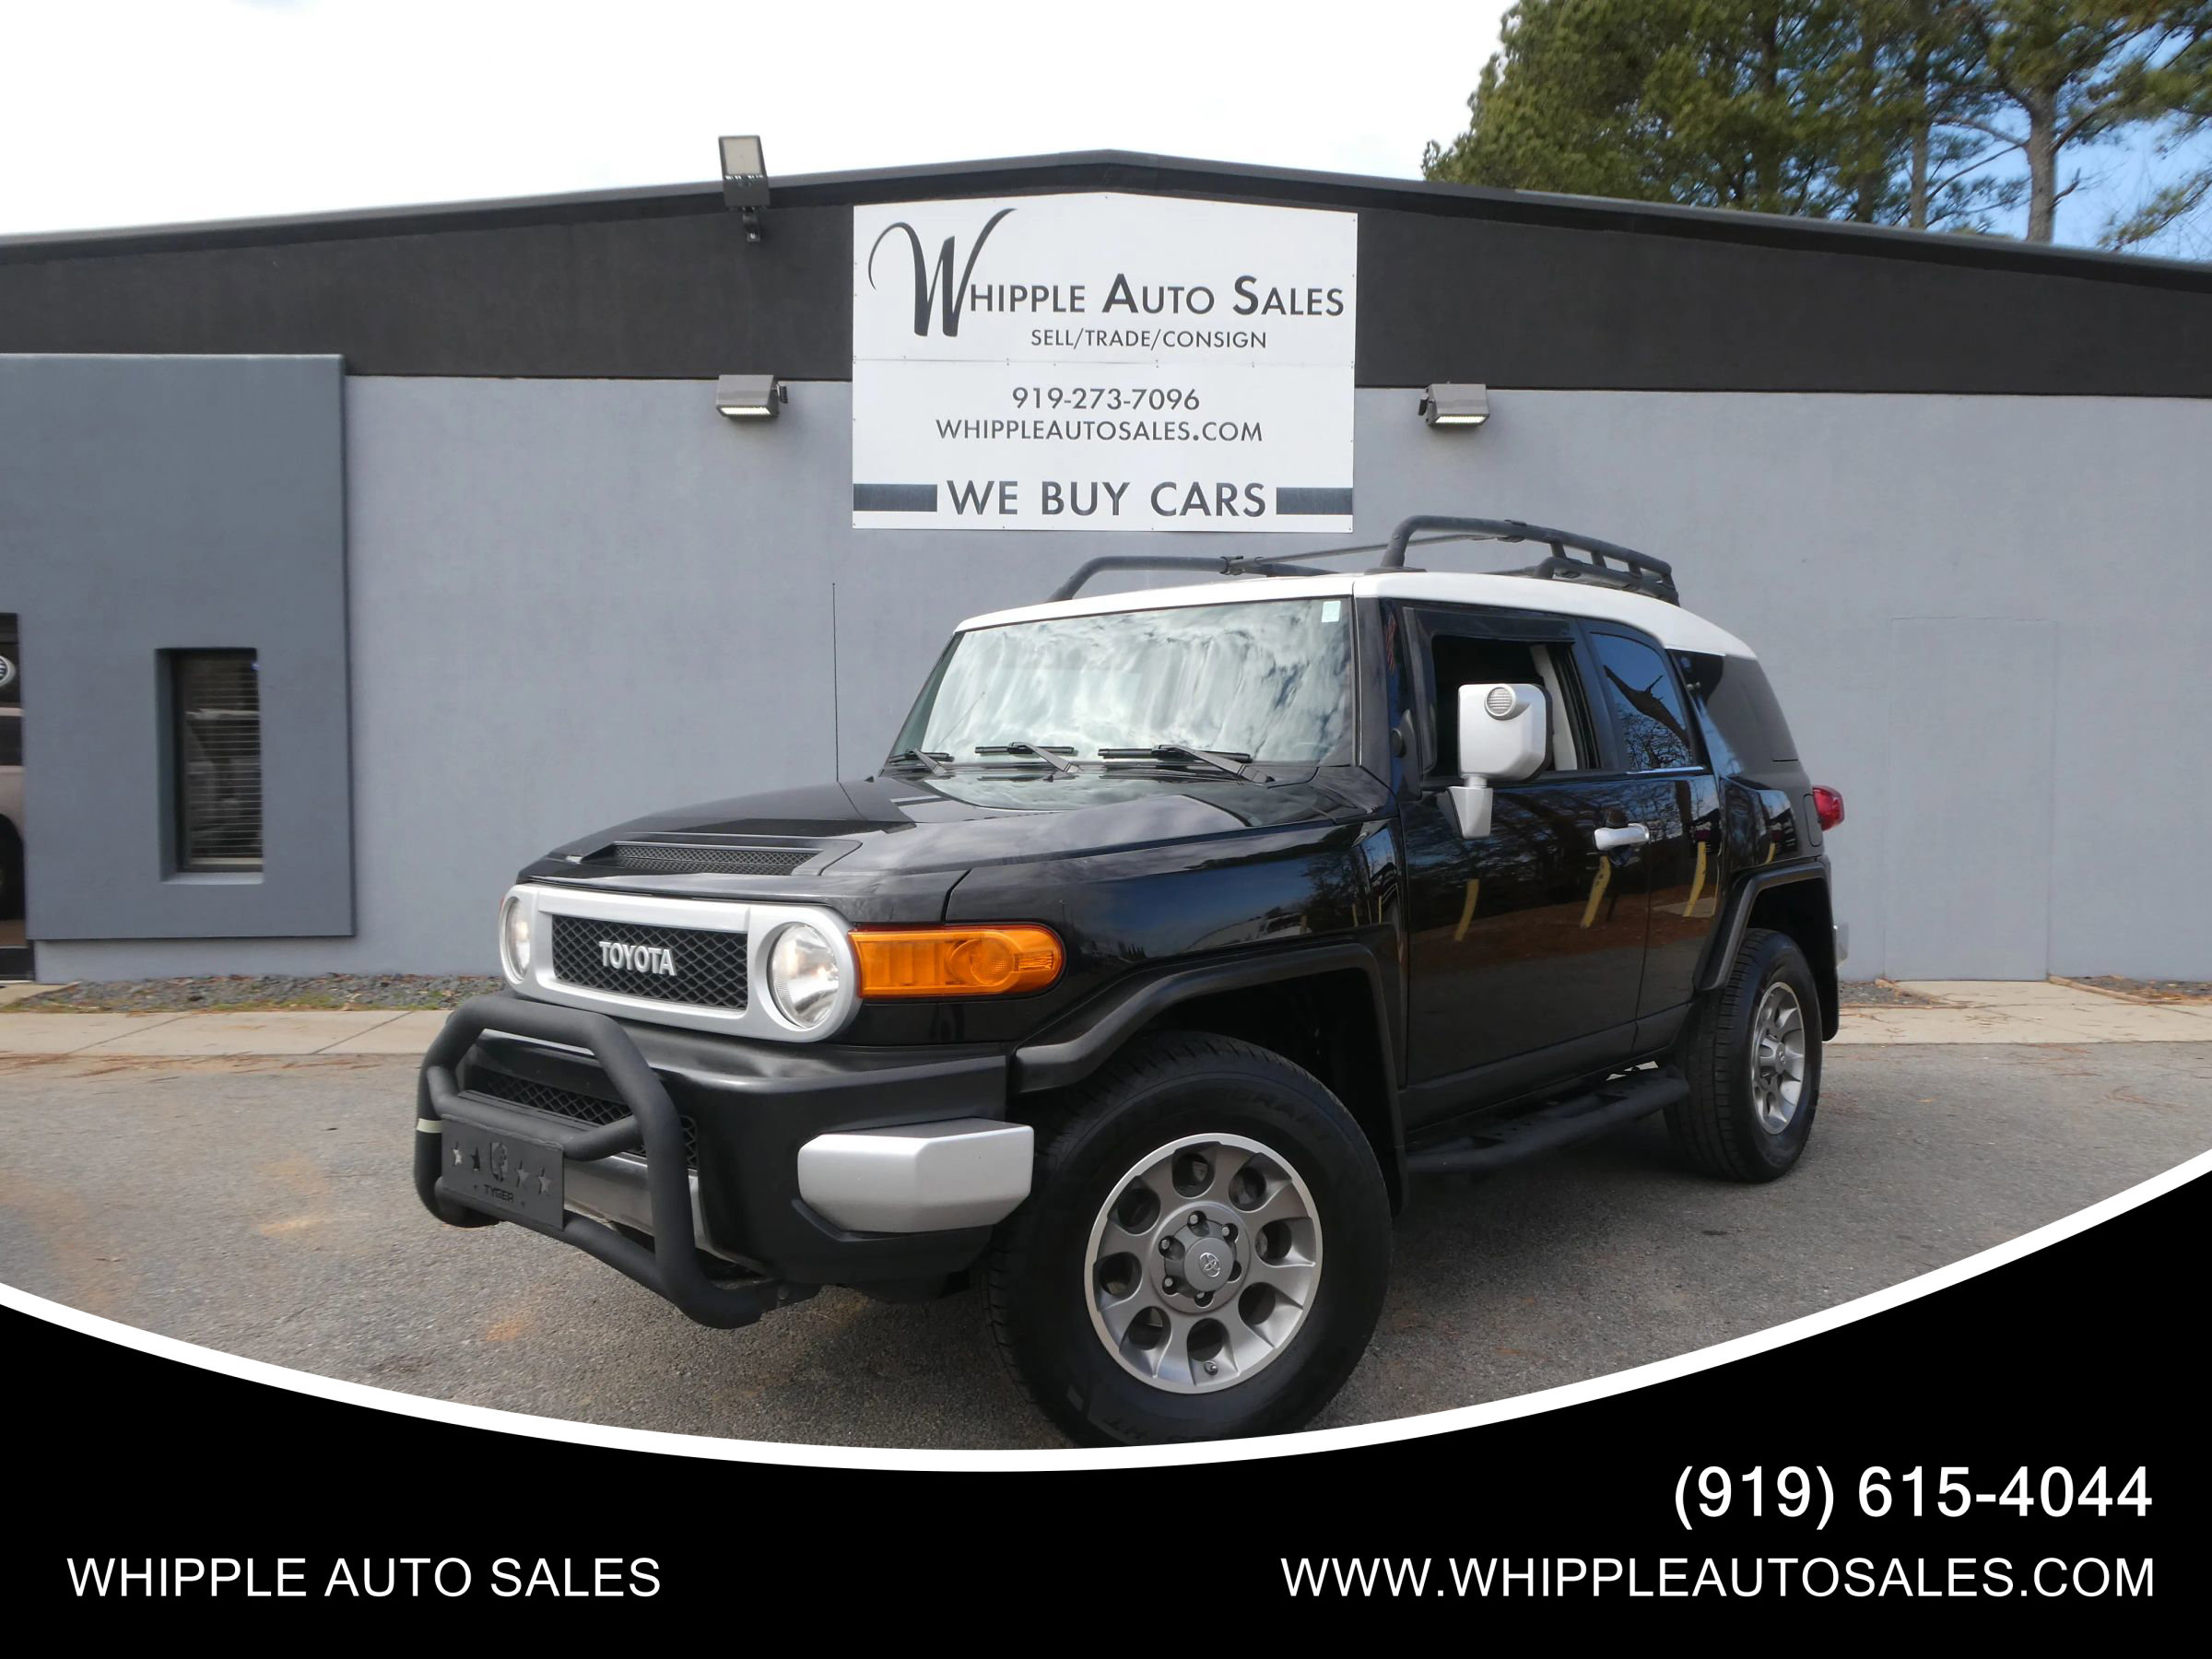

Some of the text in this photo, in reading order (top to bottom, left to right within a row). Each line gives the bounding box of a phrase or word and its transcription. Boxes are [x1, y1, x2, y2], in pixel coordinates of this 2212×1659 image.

[867, 207, 1345, 337] WHIPPLE AUTO SALES
[1031, 328, 1267, 351] SELL/TRADE/CONSIGN
[1012, 386, 1200, 411] 919-273-7096
[935, 419, 1263, 441] WHIPPLEAUTOSALES.COM
[947, 479, 1266, 518] WE BUY CARS
[599, 941, 677, 976] TOYOTA
[484, 1183, 514, 1204] TYGER
